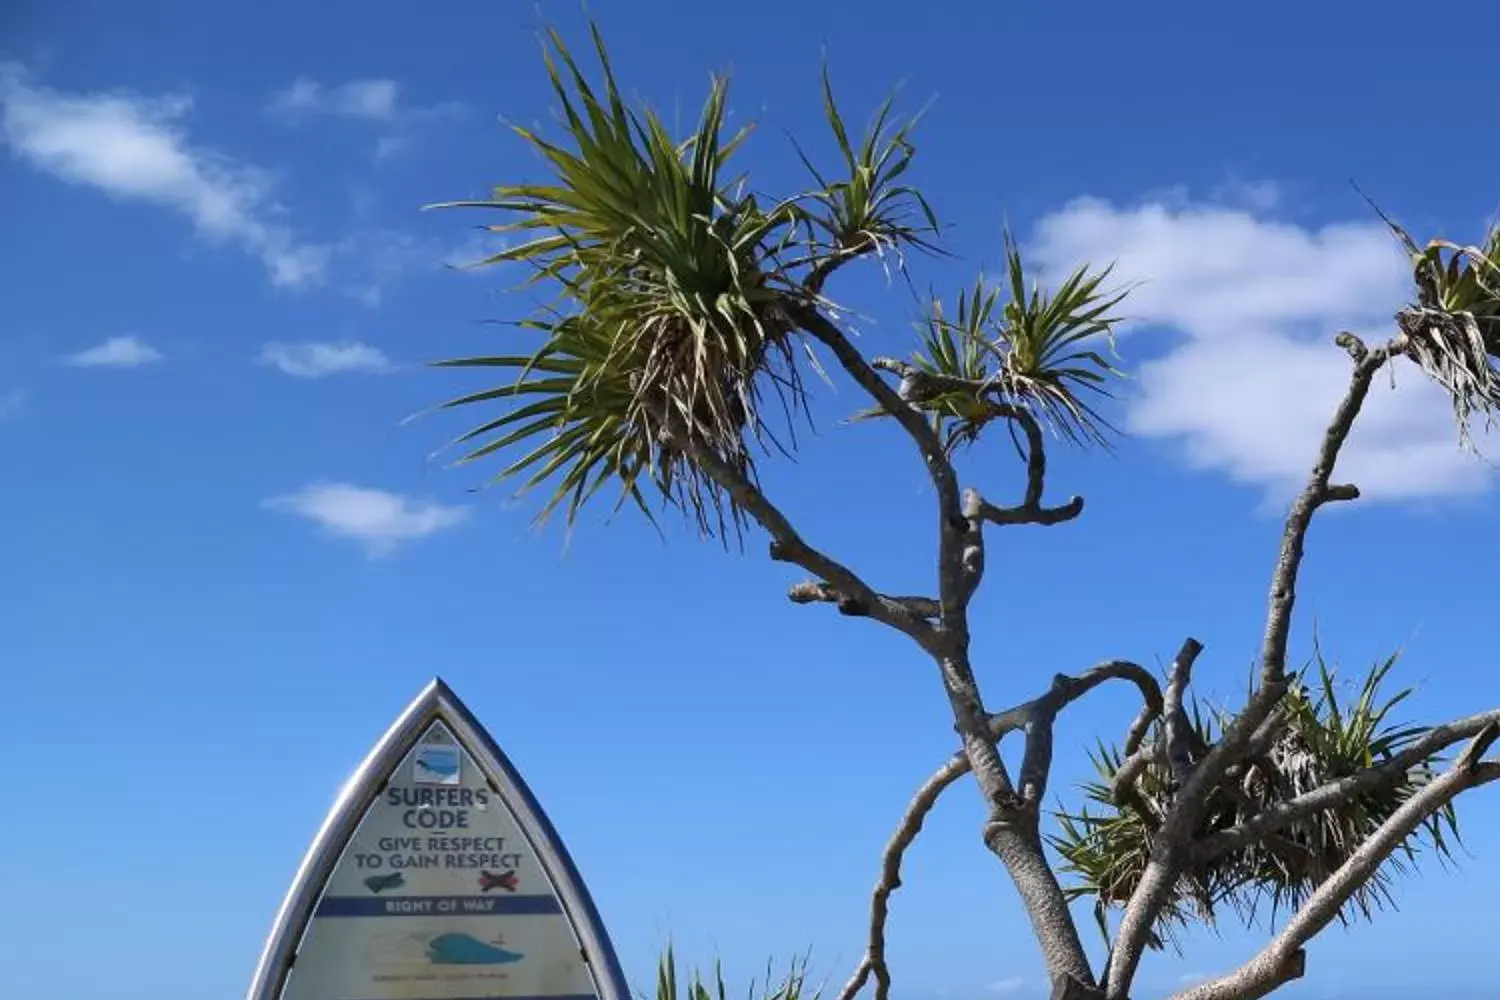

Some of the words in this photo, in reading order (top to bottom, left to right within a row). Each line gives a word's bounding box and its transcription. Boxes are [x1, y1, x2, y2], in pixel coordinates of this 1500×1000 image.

[388, 787, 489, 807] SURFERS
[403, 810, 469, 829] CODE
[379, 837, 423, 851] GIVE
[428, 837, 506, 851] RESPECT
[355, 854, 382, 869] TO
[390, 854, 440, 869] GAIN
[445, 853, 522, 869] RESPECT
[385, 900, 433, 913] RIGHT
[437, 900, 457, 912] OF
[463, 899, 496, 911] WAY
